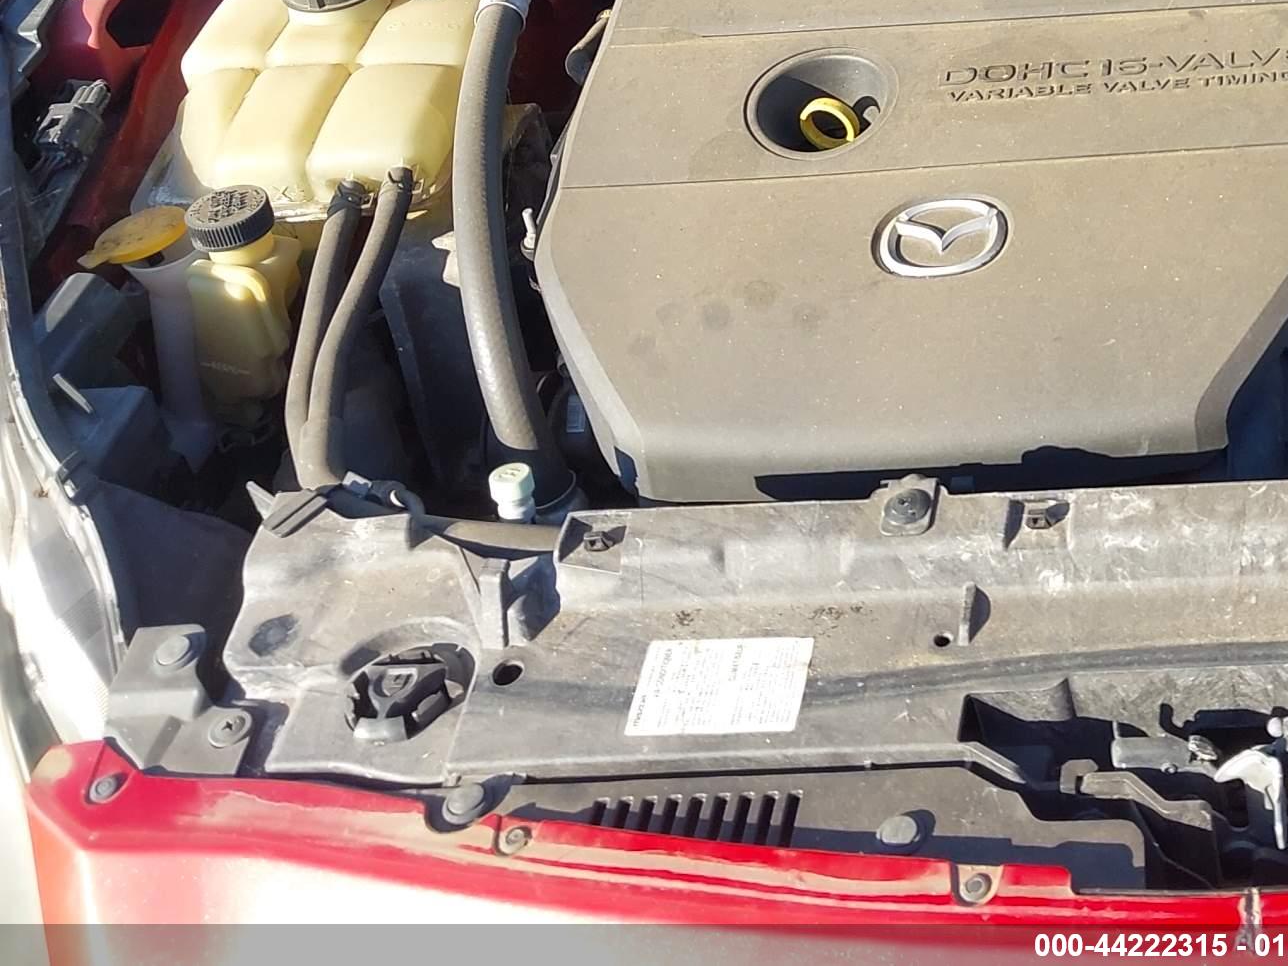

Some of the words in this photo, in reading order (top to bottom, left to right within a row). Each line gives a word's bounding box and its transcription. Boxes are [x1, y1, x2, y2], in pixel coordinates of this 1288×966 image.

[942, 59, 1091, 86] DOHC
[949, 83, 1093, 102] VARIABLE
[1103, 77, 1190, 94] VALVE
